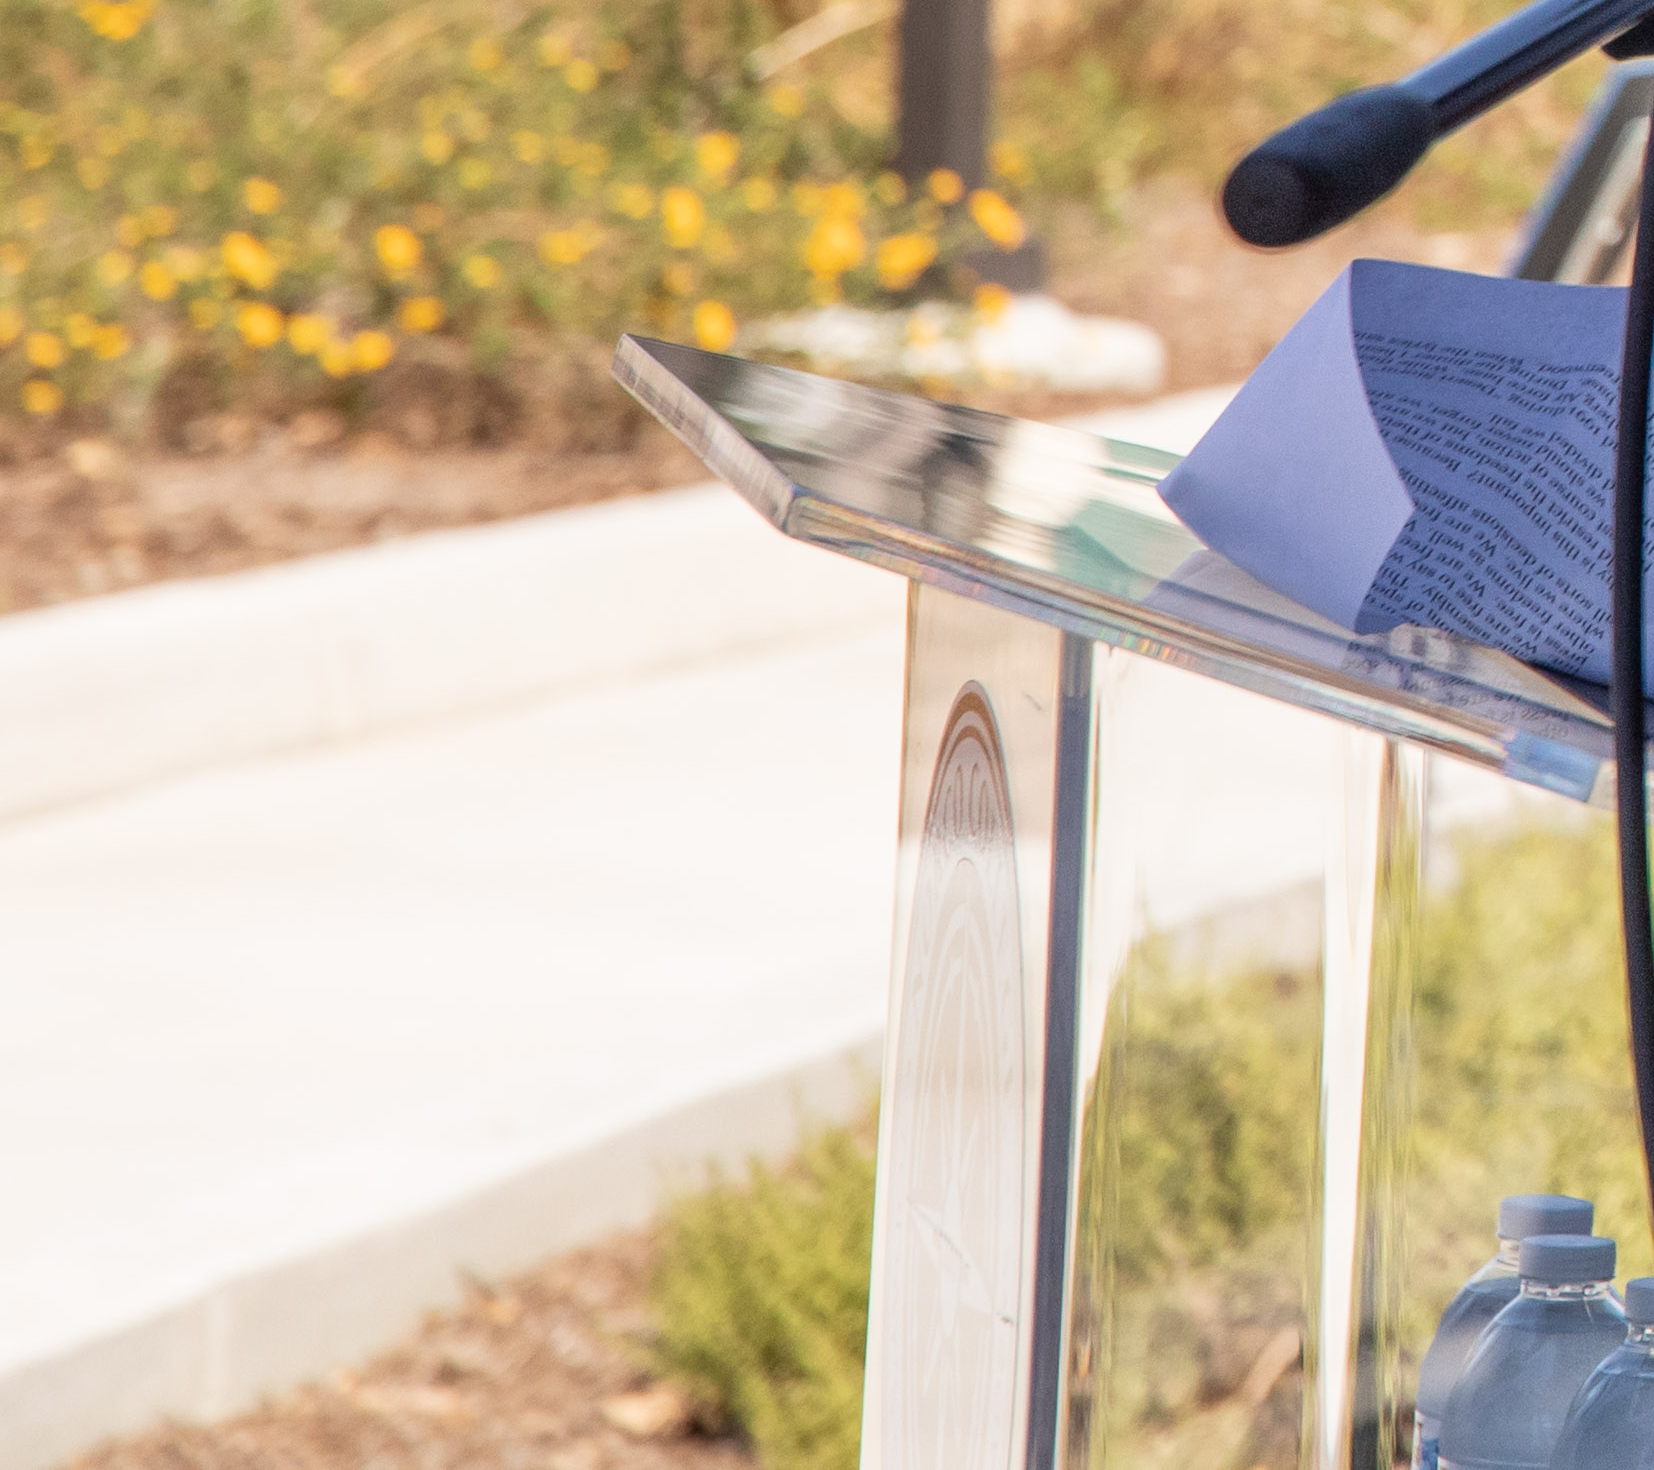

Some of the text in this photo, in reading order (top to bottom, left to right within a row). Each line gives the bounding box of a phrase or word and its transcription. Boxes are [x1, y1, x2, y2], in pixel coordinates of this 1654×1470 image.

[1523, 478, 1548, 505] the
[1444, 516, 1473, 534] are
[1470, 508, 1538, 566] decisions
[1473, 531, 1497, 558] We
[1552, 531, 1580, 560] this
[1436, 553, 1464, 571] are
[1535, 564, 1554, 580] of
[1464, 571, 1486, 598] We
[1485, 565, 1553, 624] freedoms
[1534, 583, 1556, 604] we
[1555, 577, 1593, 610] sorts
[1456, 588, 1484, 618] free
[1485, 614, 1510, 636] are
[1558, 602, 1604, 640] where
[1512, 635, 1537, 655] We
[1554, 622, 1595, 653] other
